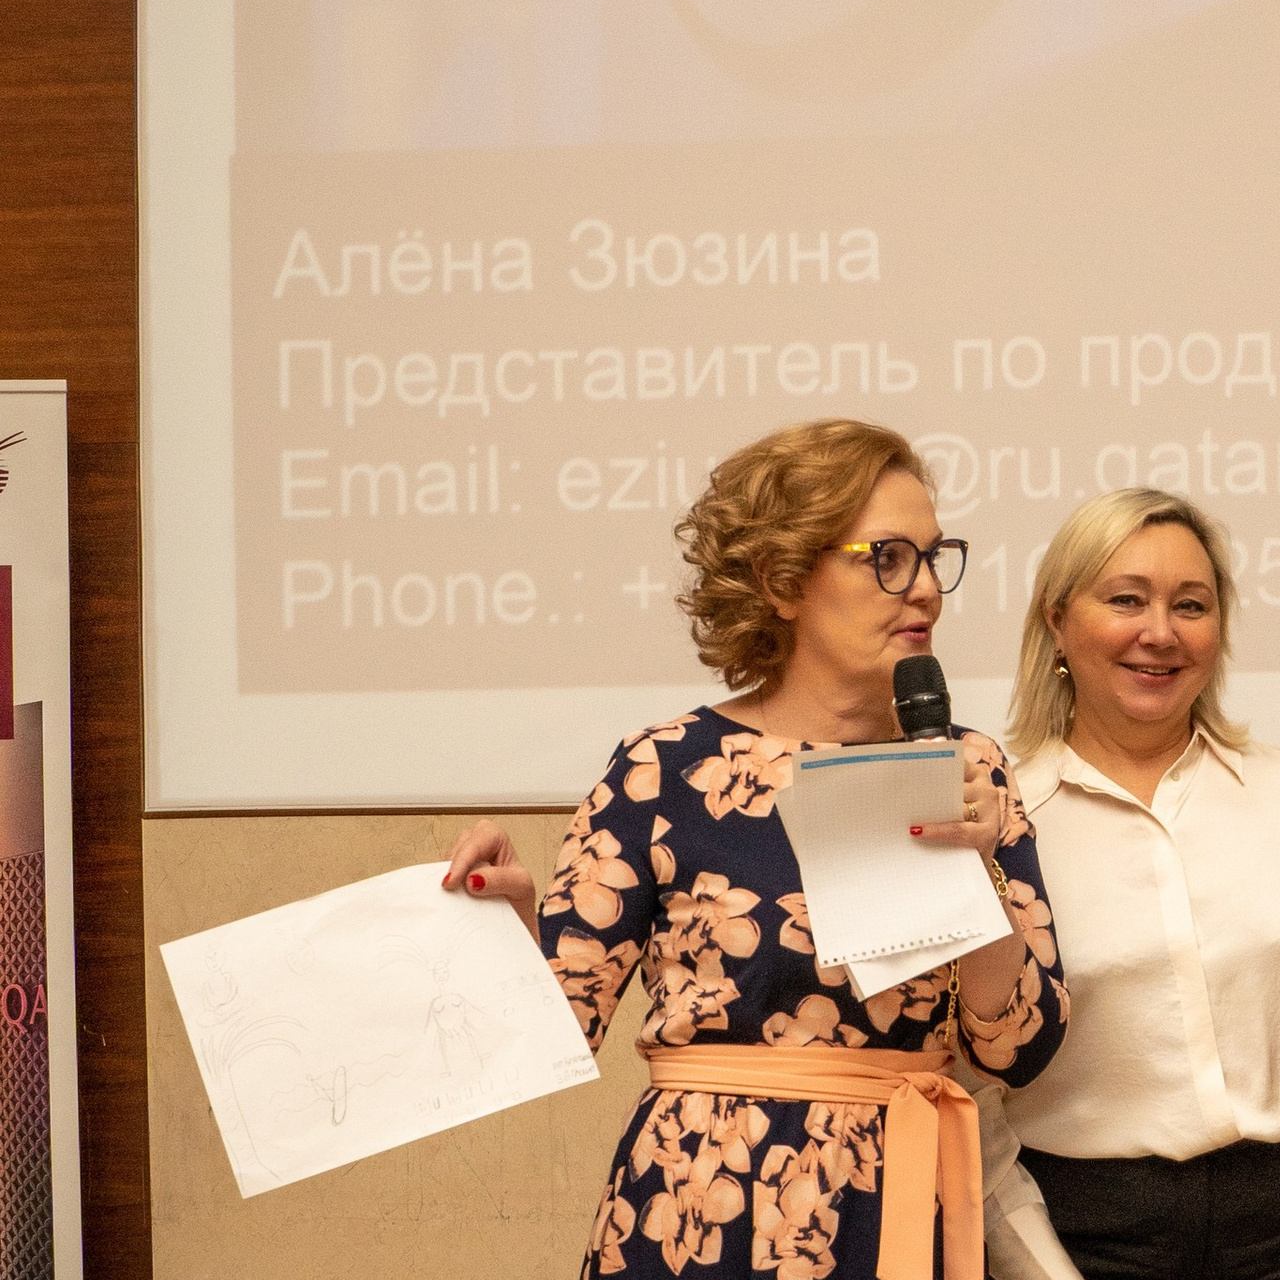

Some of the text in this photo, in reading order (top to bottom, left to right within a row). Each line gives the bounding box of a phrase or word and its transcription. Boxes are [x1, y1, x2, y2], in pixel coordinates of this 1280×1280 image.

[273, 218, 881, 299] Алёна Зюзина
[278, 338, 919, 426] Представитель
[953, 333, 1046, 391] по
[279, 443, 521, 518] Email:
[281, 558, 584, 630] Phone.:
